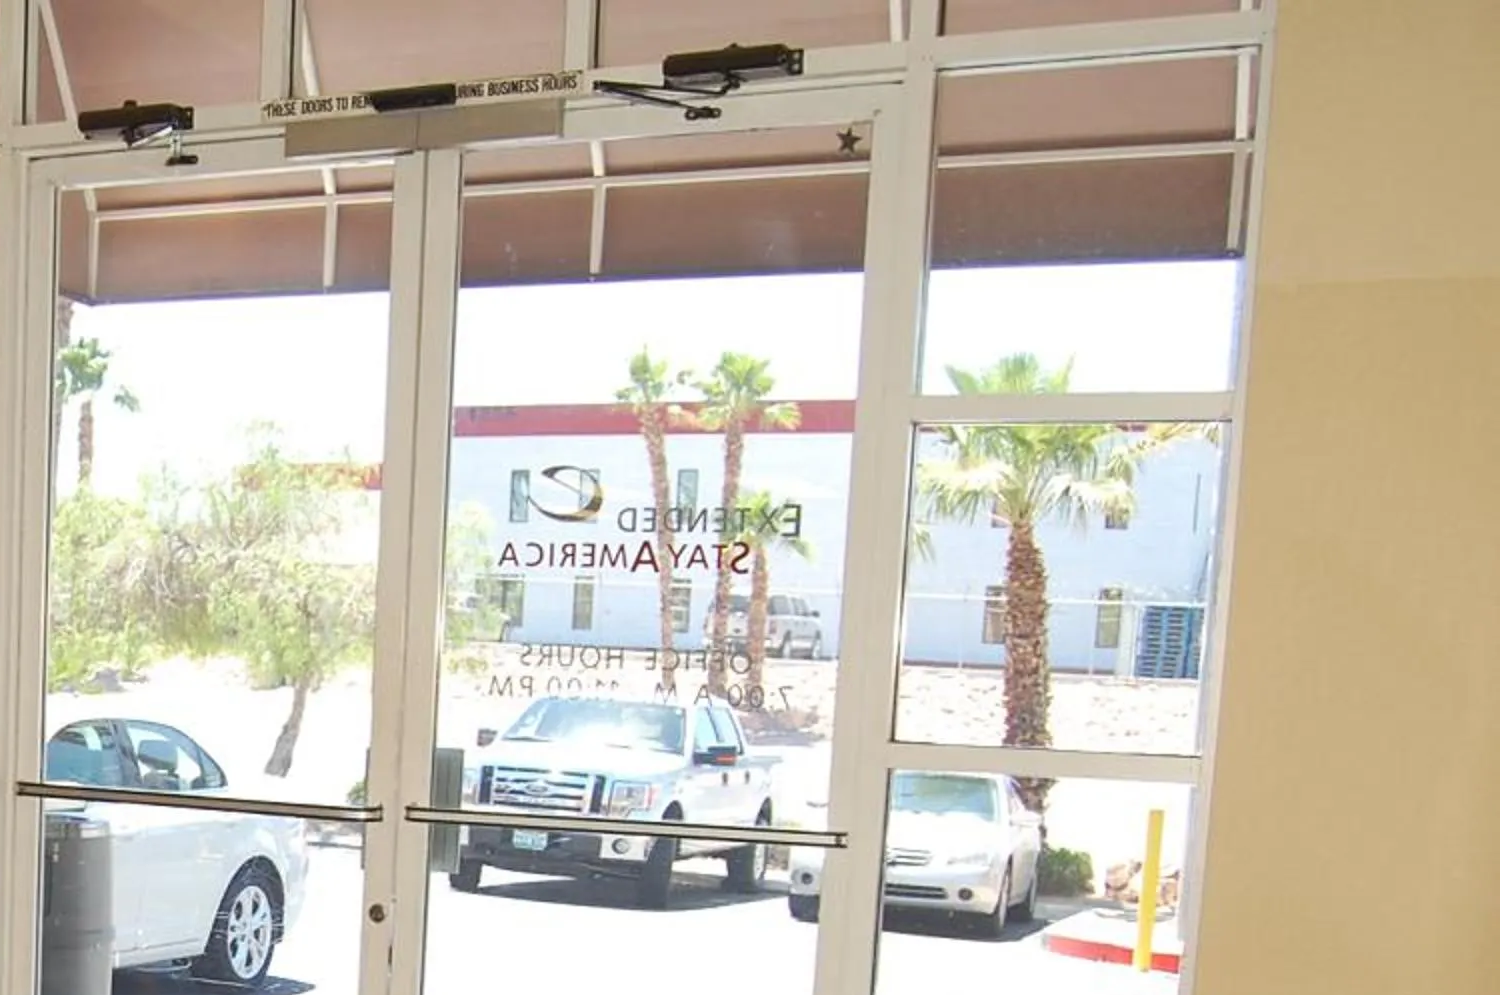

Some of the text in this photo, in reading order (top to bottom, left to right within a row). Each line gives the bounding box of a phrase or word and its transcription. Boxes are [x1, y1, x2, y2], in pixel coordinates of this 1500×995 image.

[301, 98, 333, 115] DOORS
[335, 96, 349, 111] TO
[487, 79, 539, 96] BUSINESS
